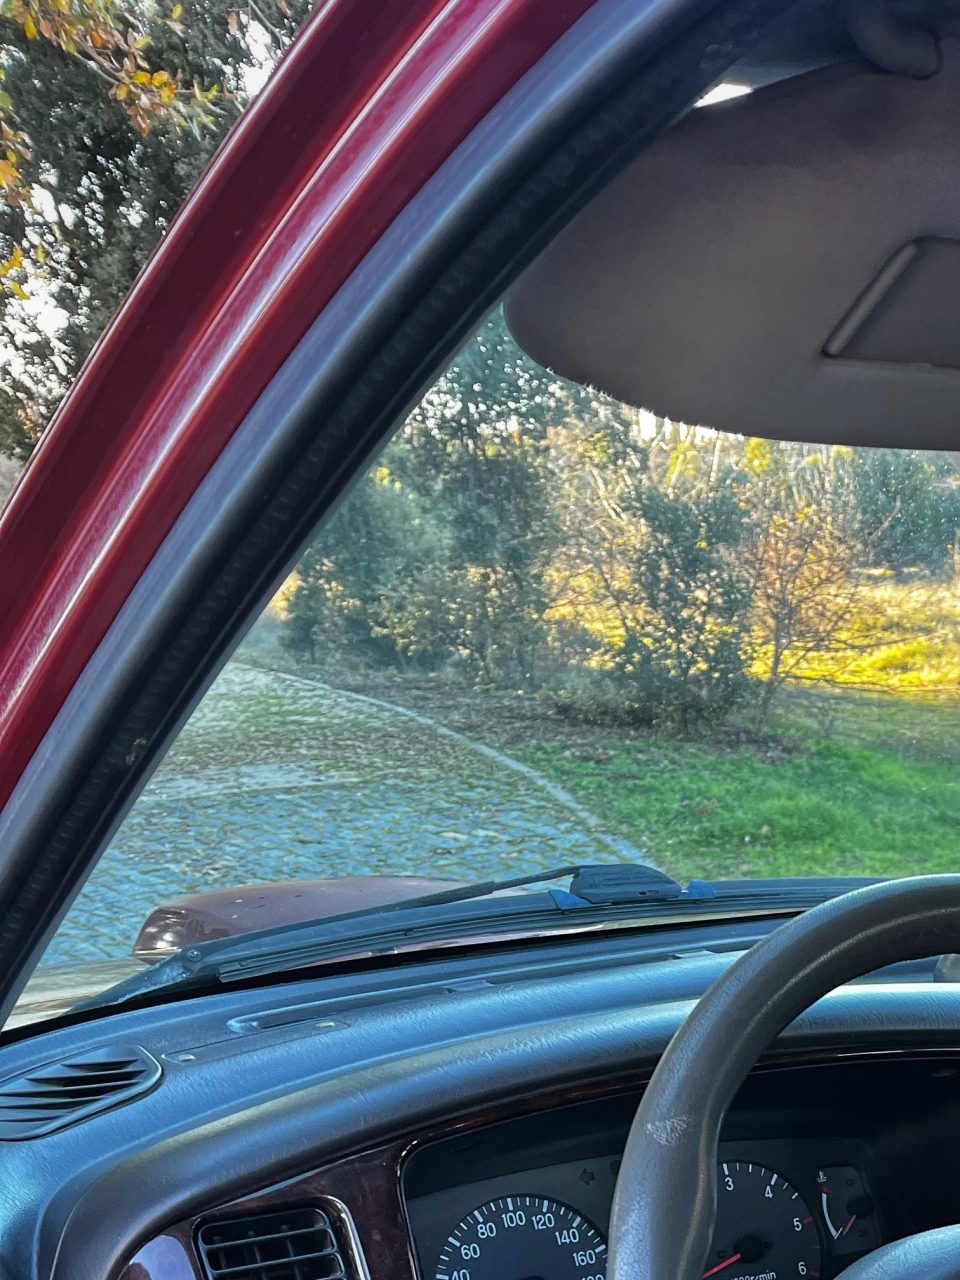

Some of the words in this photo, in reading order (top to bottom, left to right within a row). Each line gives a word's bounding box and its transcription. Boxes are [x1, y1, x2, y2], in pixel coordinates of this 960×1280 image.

[724, 1177, 734, 1191] 3
[764, 1186, 773, 1199] 4
[501, 1211, 526, 1228] 100
[532, 1213, 555, 1230] 120
[793, 1218, 802, 1231] 5
[477, 1222, 497, 1239] 80
[555, 1228, 579, 1246] 140
[460, 1243, 480, 1260] 60
[573, 1250, 596, 1267] 160
[798, 1261, 807, 1275] 6
